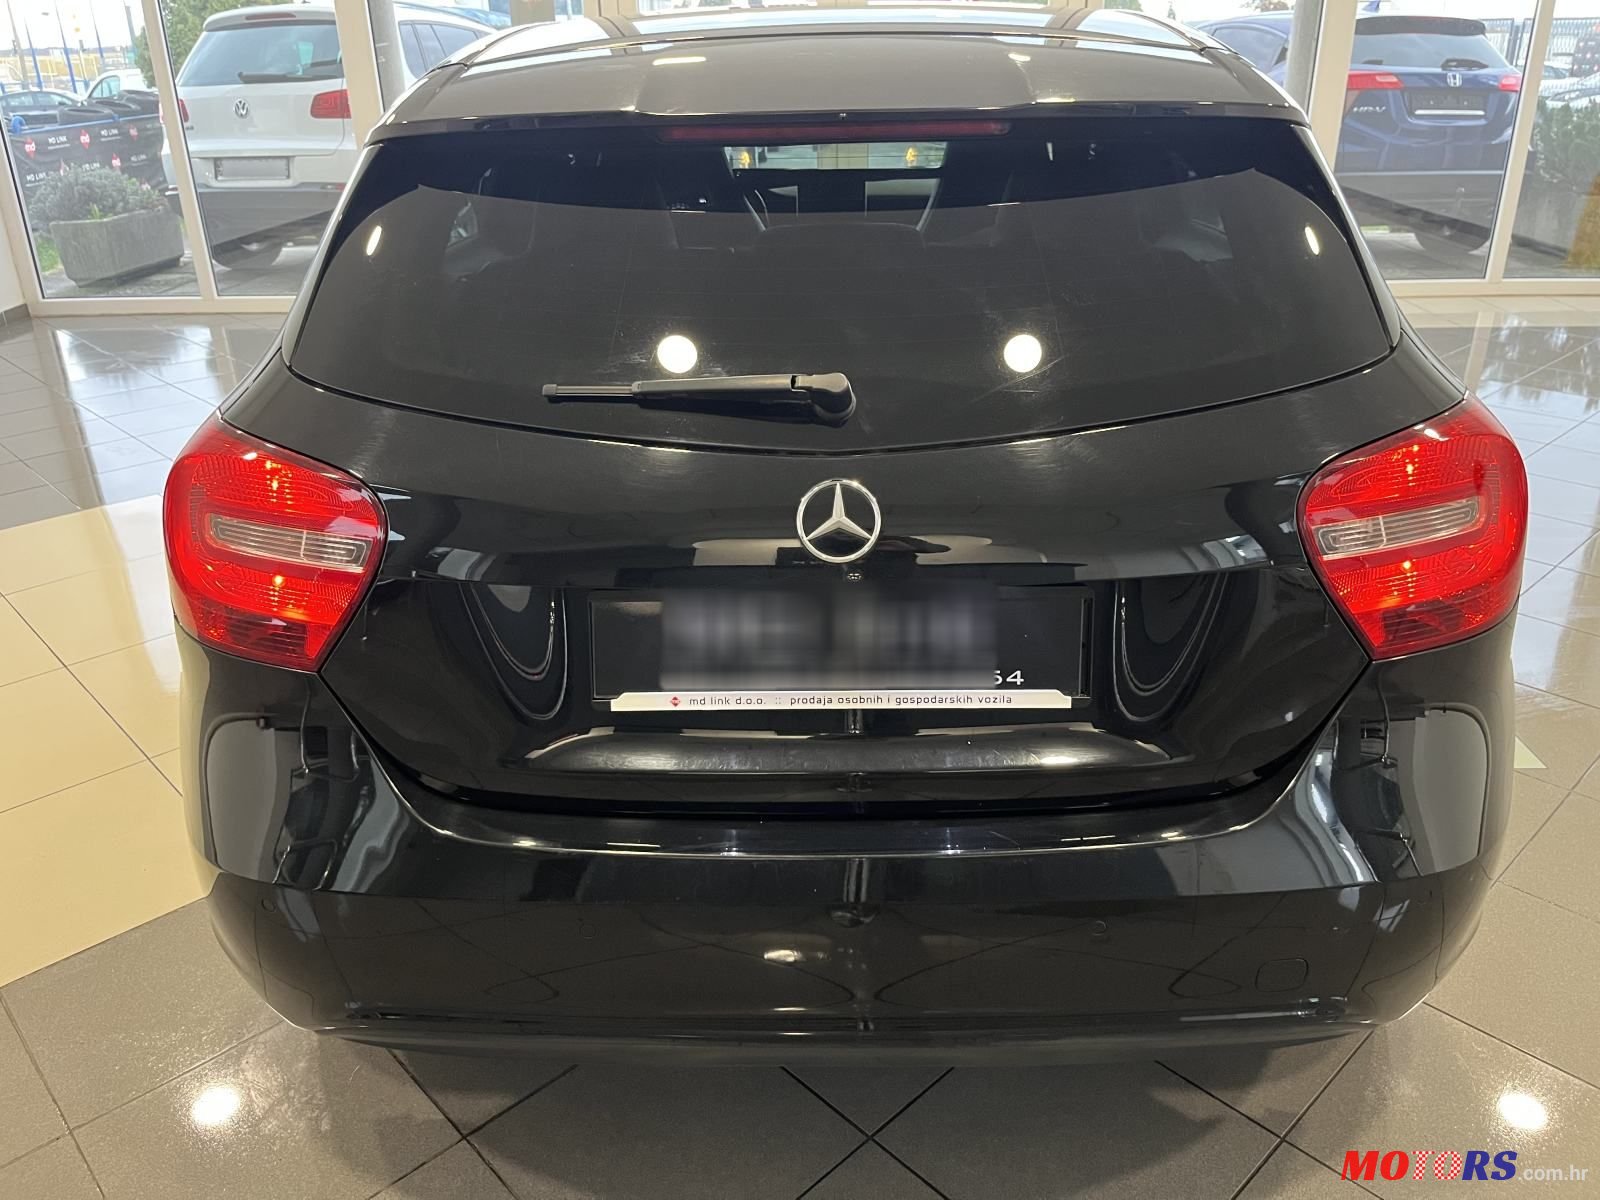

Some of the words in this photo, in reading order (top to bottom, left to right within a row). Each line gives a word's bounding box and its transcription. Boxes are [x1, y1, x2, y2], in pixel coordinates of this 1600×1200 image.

[689, 696, 706, 705] md
[710, 696, 730, 705] link
[790, 696, 833, 706] prodaja
[837, 695, 883, 704] osobnih
[895, 695, 973, 706] gospodarskih
[978, 695, 1012, 704] vozila
